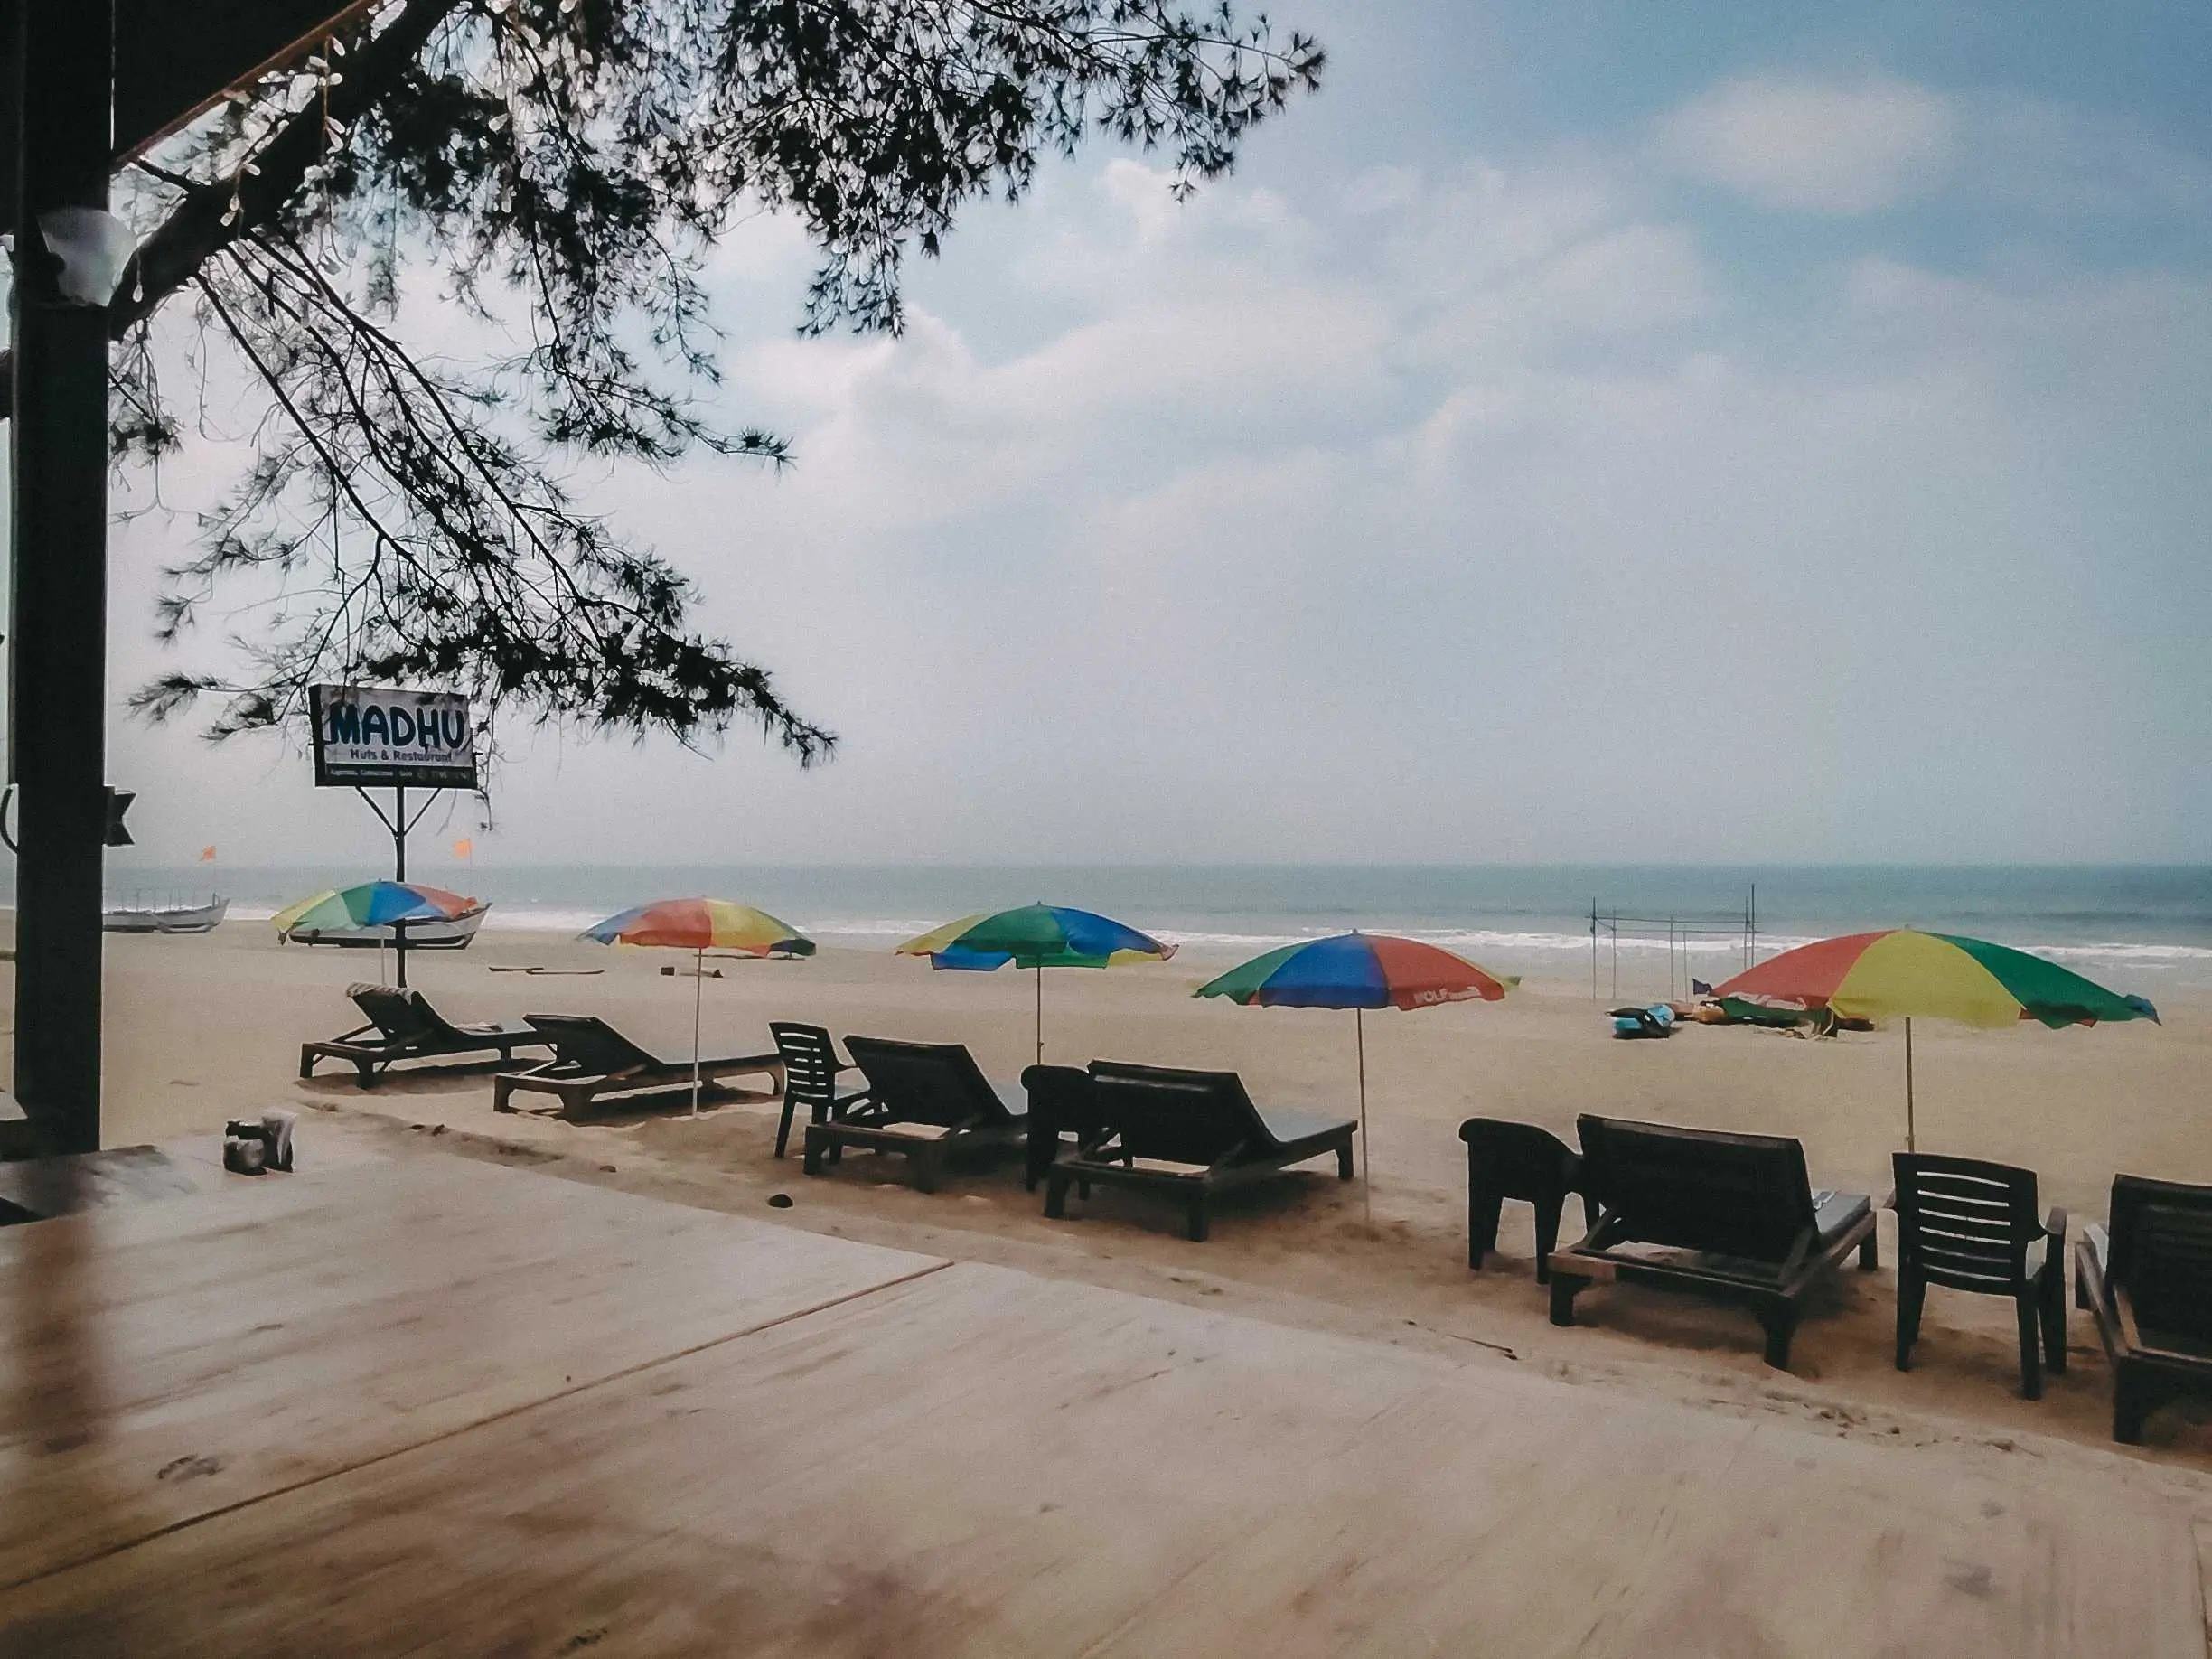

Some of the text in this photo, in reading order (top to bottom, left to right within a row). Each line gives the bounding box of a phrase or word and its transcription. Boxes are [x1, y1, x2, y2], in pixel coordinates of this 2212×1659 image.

[329, 703, 464, 749] MADHU
[350, 748, 452, 763] Huts & Restaurant
